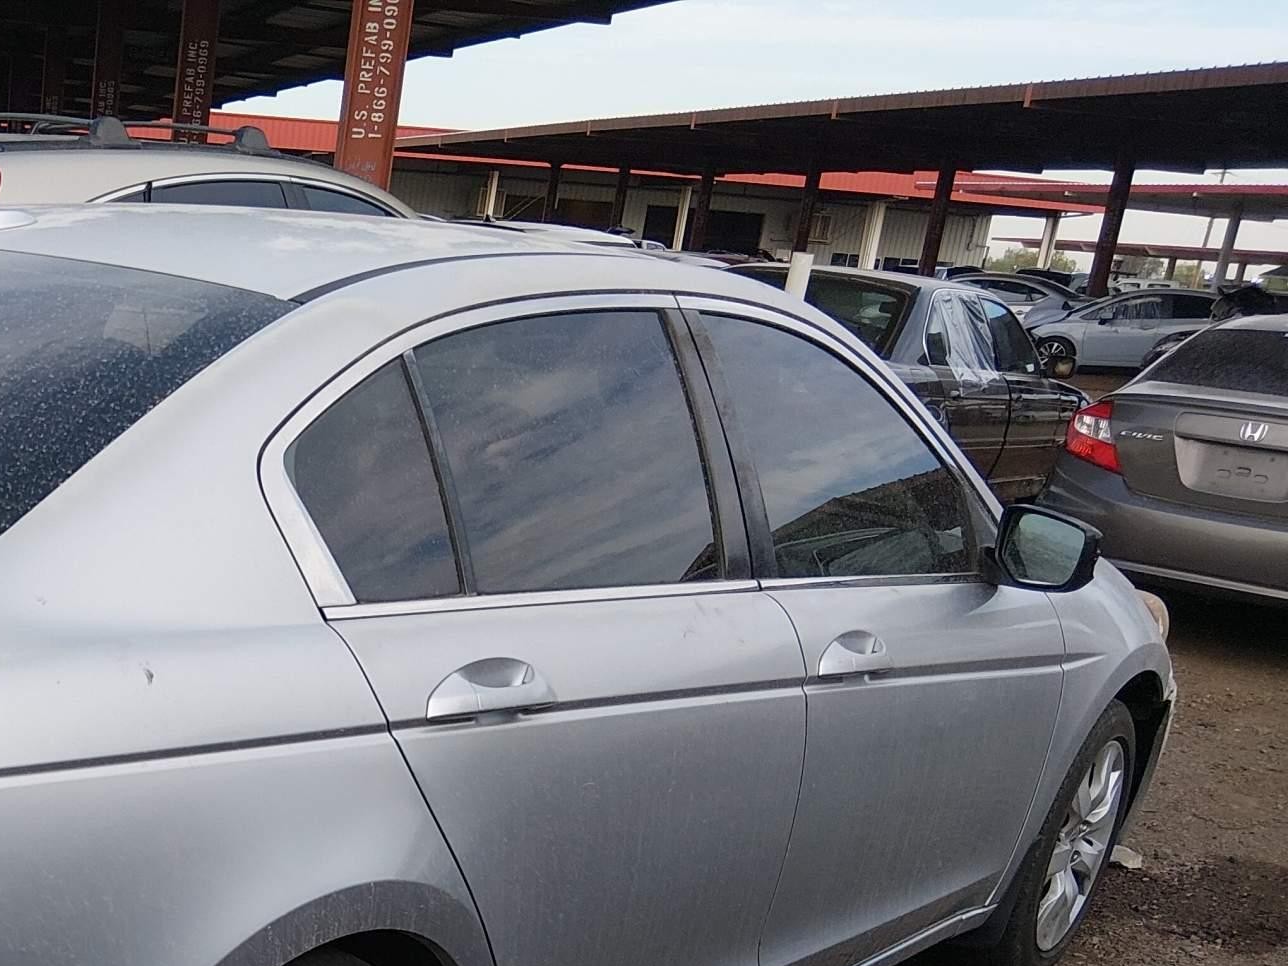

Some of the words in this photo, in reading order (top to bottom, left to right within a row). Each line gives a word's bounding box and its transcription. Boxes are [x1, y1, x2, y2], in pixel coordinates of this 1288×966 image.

[357, 21, 380, 94] PREFAB
[182, 67, 196, 116] PREFAB
[351, 104, 369, 139] U.S.
[1119, 430, 1164, 441] CIVIC
